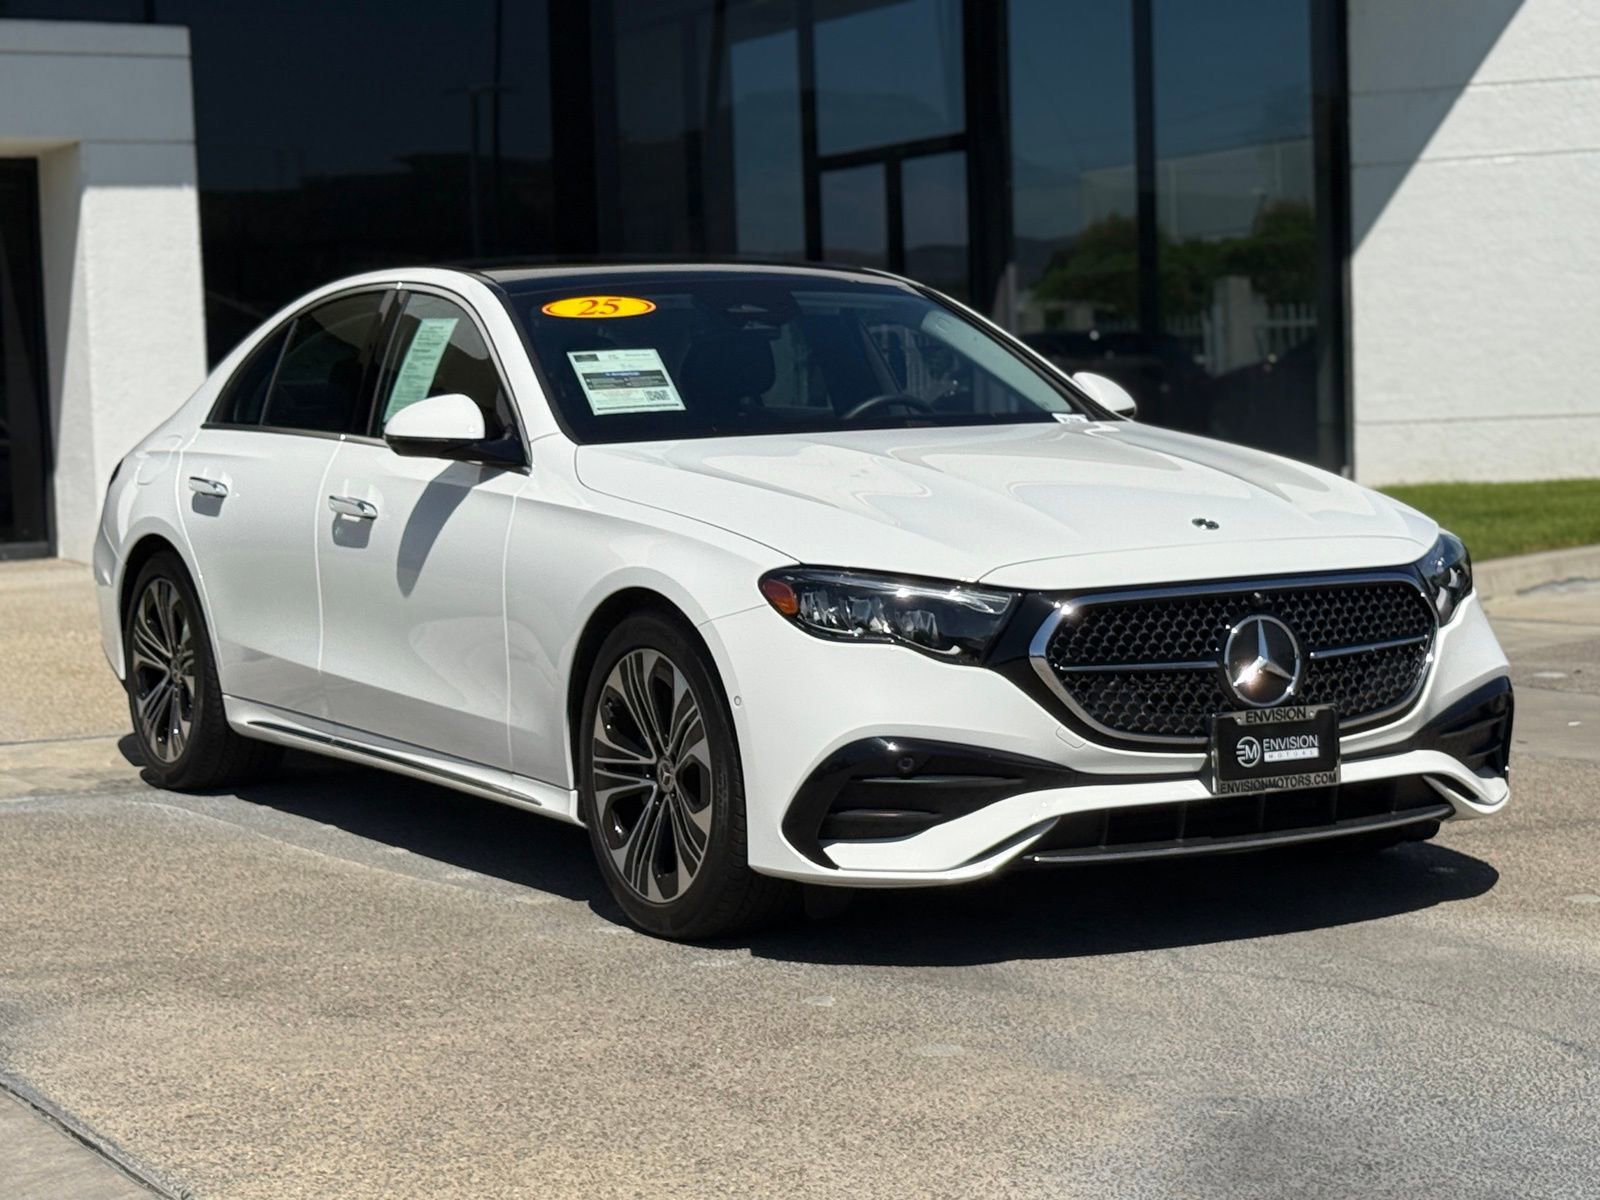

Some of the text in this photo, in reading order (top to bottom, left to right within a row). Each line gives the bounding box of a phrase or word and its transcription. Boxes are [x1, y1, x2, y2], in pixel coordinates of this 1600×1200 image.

[577, 298, 622, 316] 25
[1245, 708, 1307, 723] ENVISION
[1263, 734, 1318, 751] ENVISION
[1220, 773, 1337, 794] ENVISIONMOTORS.COM
